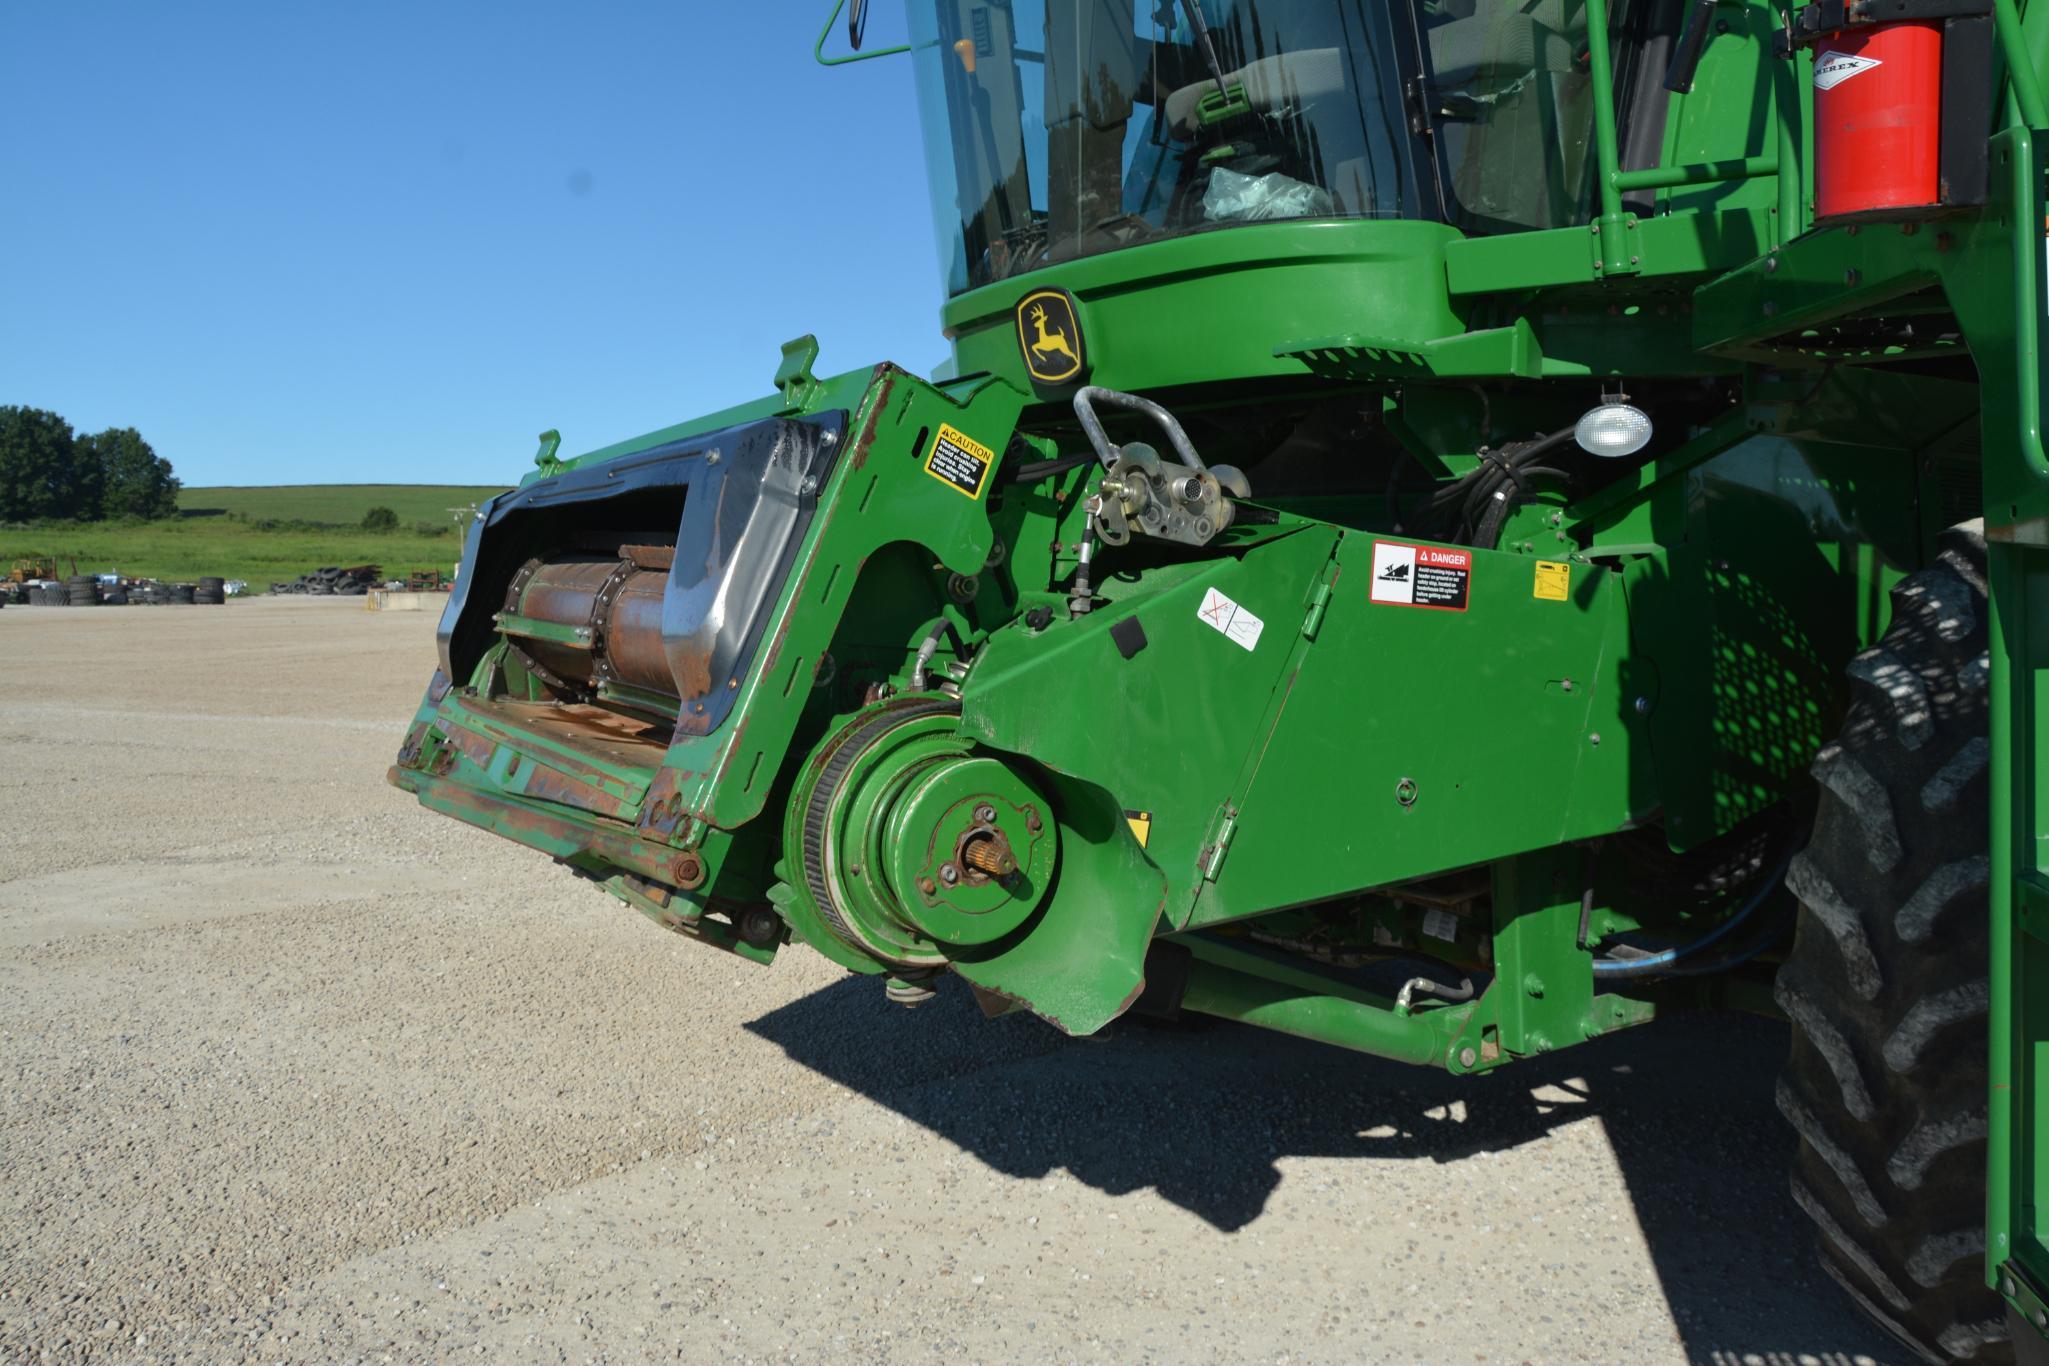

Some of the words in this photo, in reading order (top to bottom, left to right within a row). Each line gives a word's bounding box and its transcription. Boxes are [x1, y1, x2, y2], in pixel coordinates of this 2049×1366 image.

[940, 439, 960, 453] Header
[960, 451, 971, 460] can
[950, 431, 991, 461] CAUTION
[938, 445, 954, 457] Avoid
[953, 455, 977, 472] crushing
[946, 464, 959, 475] when
[959, 472, 975, 484] engine
[957, 463, 971, 475] Stay
[1431, 552, 1466, 565] DANGER
